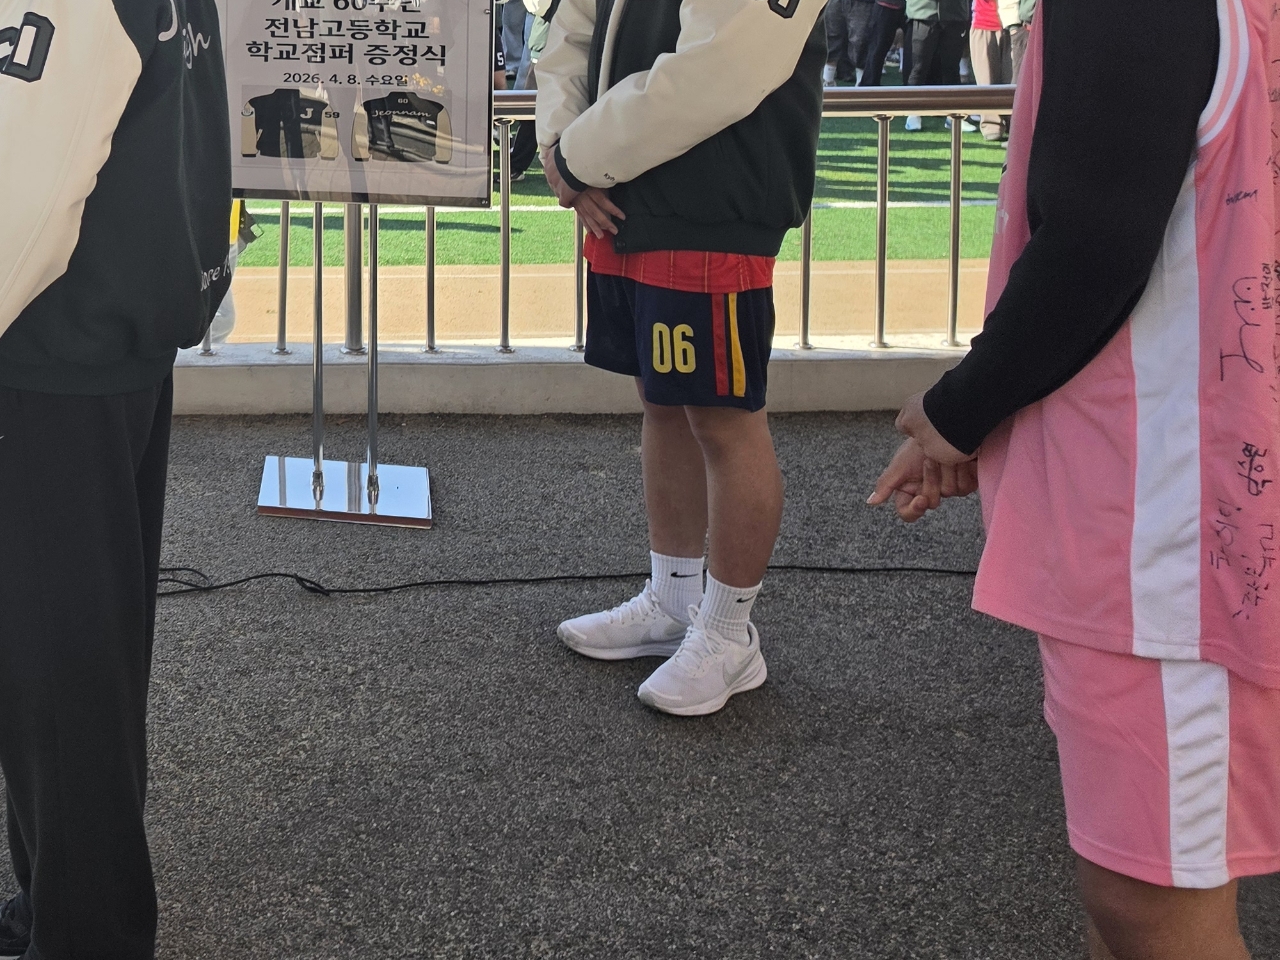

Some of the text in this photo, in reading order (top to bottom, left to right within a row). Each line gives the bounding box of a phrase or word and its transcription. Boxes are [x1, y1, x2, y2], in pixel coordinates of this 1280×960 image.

[264, 17, 431, 41] 전남고등학교
[246, 40, 447, 67] 학교점퍼 증정식
[328, 73, 343, 85] 4.
[347, 74, 361, 86] 8.
[365, 74, 409, 87] 수요일
[299, 107, 314, 119] J
[324, 111, 340, 119] 59
[652, 322, 697, 374] 06
